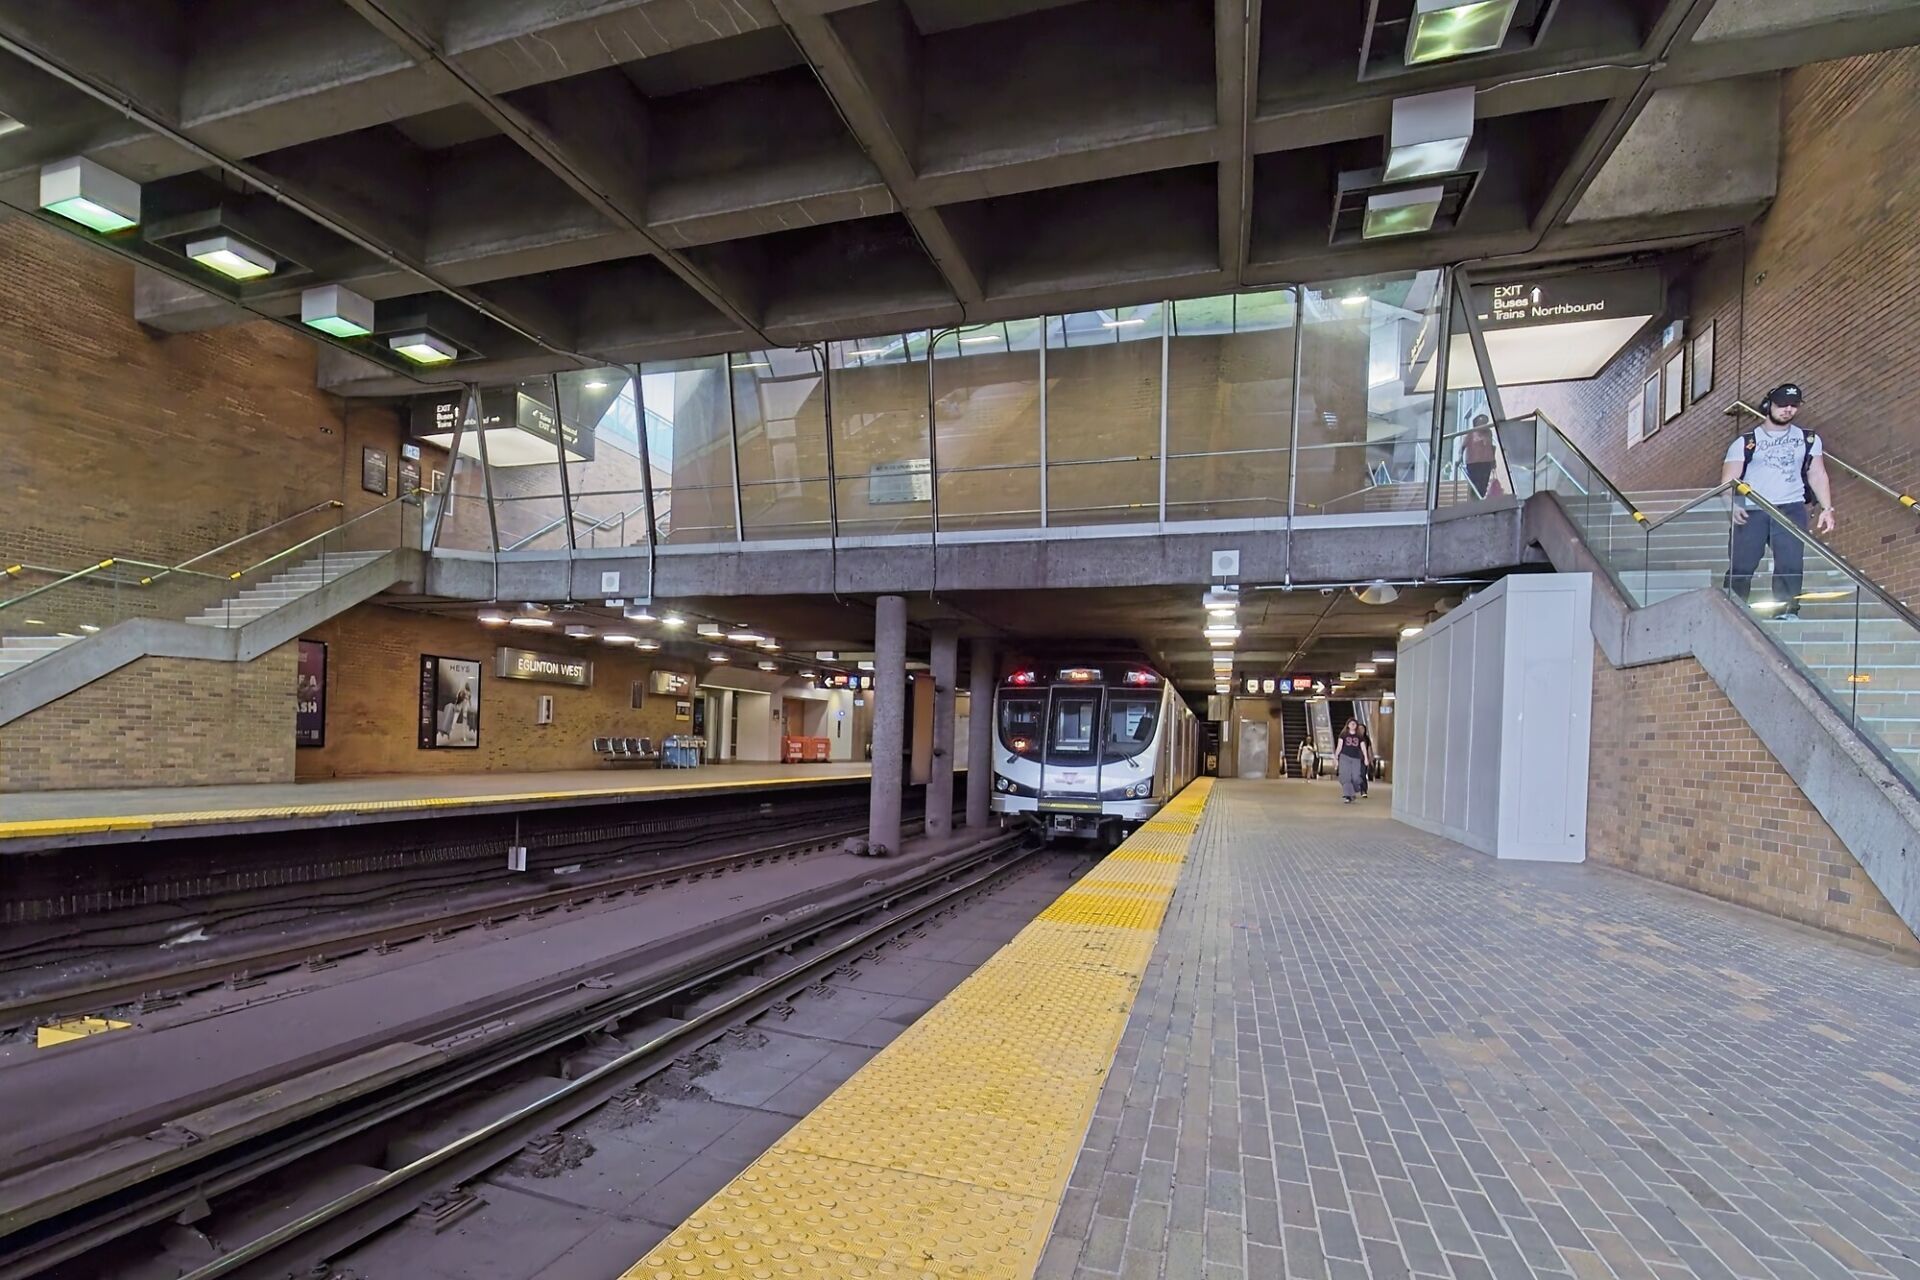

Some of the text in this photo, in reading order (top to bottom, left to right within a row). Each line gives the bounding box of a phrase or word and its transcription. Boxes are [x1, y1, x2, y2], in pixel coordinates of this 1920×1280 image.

[1494, 284, 1523, 298] EXIT
[1494, 298, 1529, 309] Buses
[1493, 300, 1605, 321] Trains Northbound
[436, 404, 452, 412] EXIT
[449, 664, 470, 673] HEYS
[518, 658, 583, 677] EGLINTON WEST
